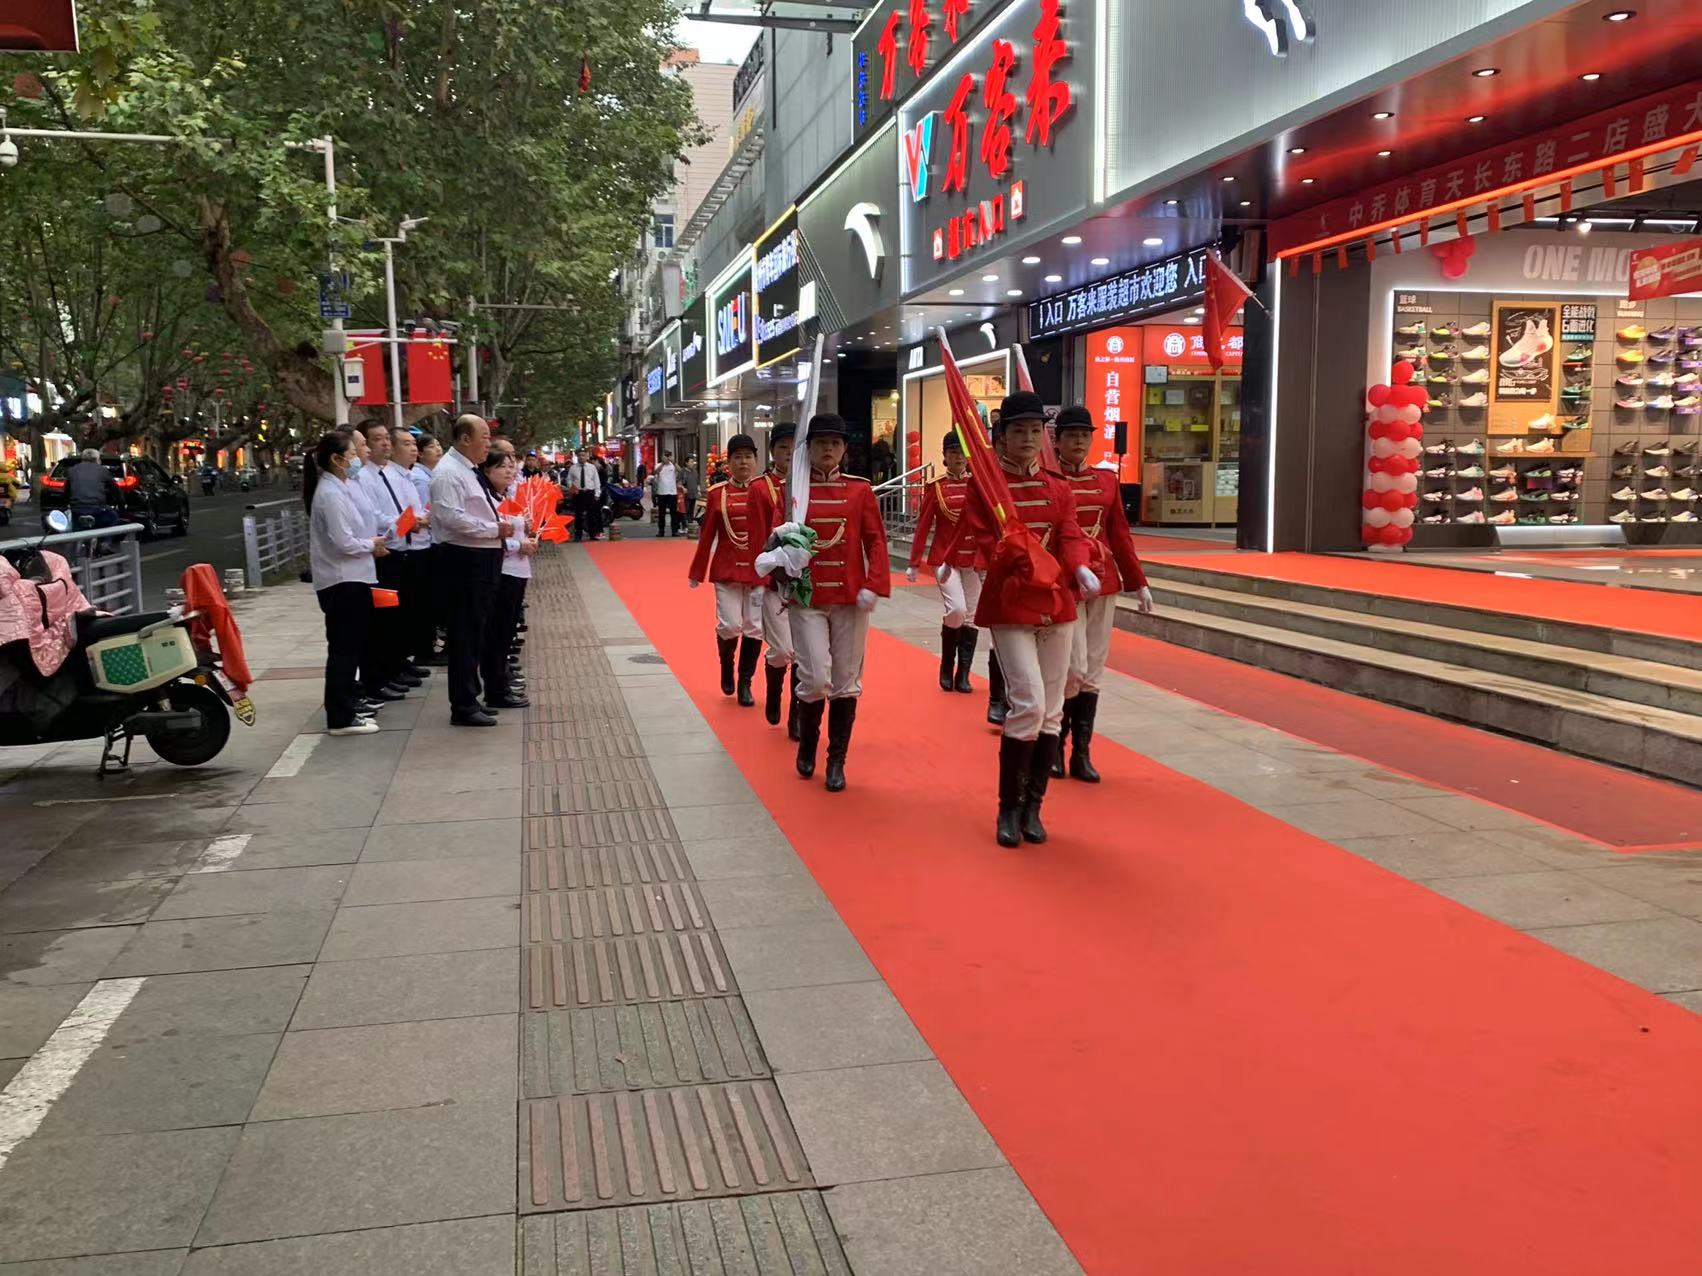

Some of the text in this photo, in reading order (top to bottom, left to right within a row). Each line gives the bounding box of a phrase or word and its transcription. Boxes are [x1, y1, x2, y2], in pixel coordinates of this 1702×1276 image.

[1523, 244, 1581, 281] ONE
[1067, 262, 1178, 322] 万客来服装超市欢迎您
